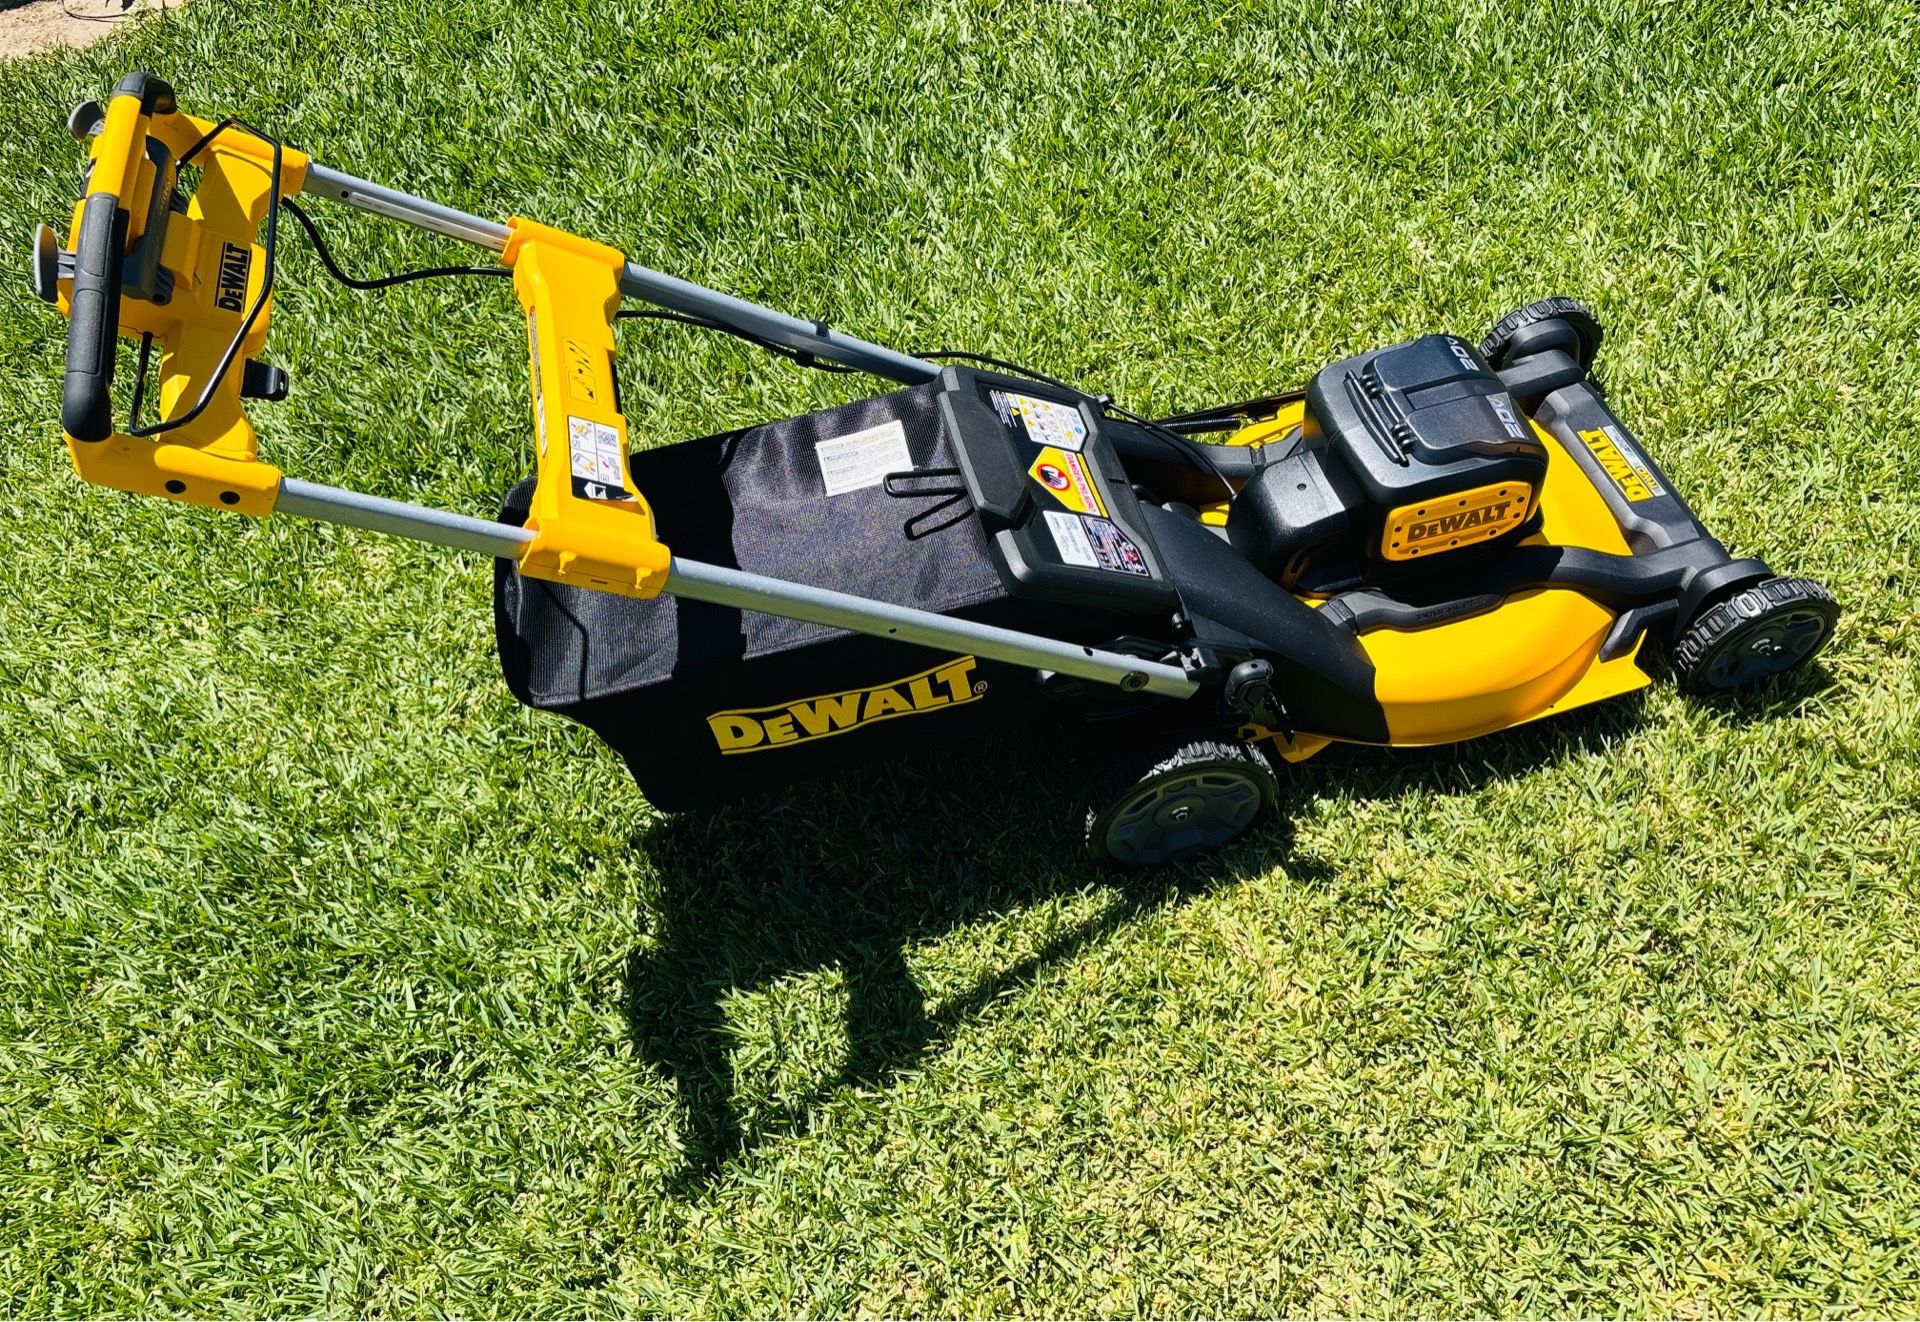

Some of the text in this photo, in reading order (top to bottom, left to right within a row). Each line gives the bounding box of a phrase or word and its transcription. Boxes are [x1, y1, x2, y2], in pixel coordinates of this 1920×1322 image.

[217, 242, 250, 313] DEWALT
[1491, 398, 1529, 440] 20V
[1577, 427, 1653, 502] DEWALT
[1407, 501, 1511, 543] DEWALT
[707, 656, 977, 754] DEWALT
